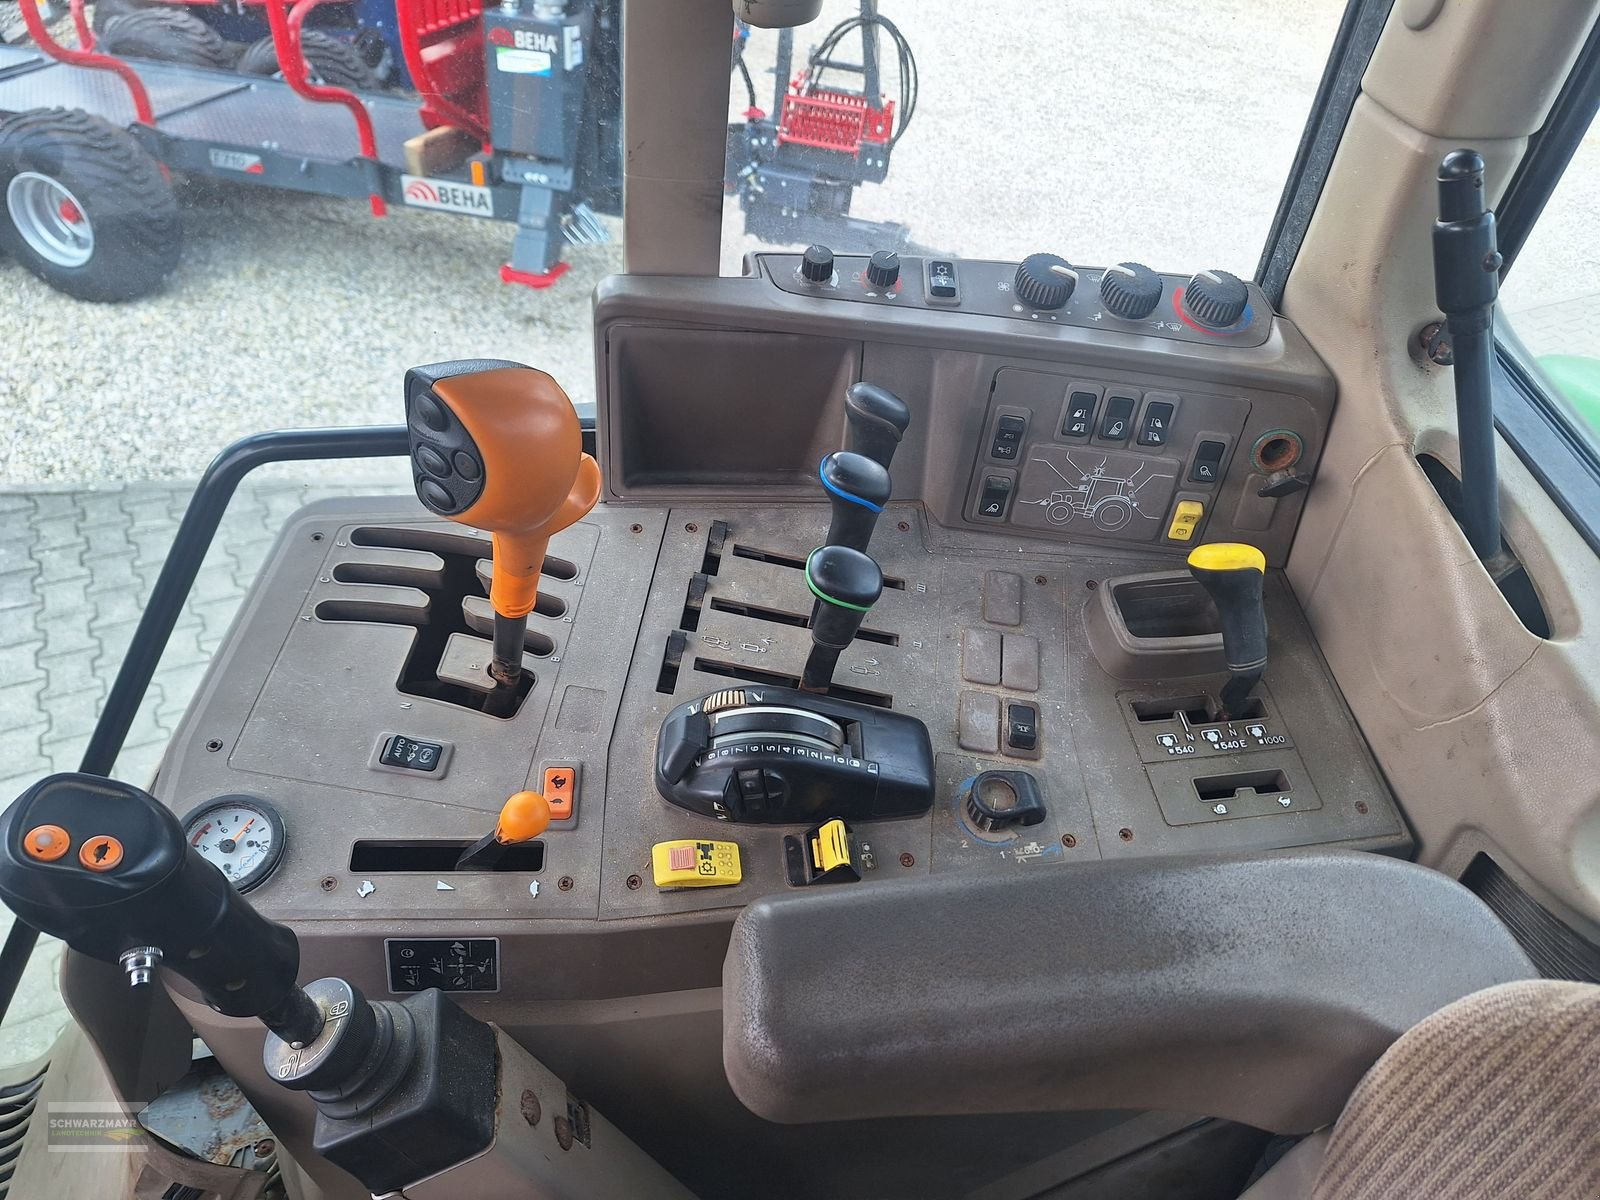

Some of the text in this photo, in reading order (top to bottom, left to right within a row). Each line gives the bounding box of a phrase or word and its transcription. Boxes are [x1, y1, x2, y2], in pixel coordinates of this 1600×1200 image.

[514, 30, 558, 54] BEHA
[437, 186, 489, 210] BEHA
[1186, 733, 1195, 741] N
[1228, 729, 1237, 737] N
[1264, 735, 1285, 745] 1000
[393, 738, 406, 758] AUTO
[1175, 745, 1195, 755] 540
[708, 752, 716, 760] 9
[782, 746, 791, 754] 4
[797, 748, 805, 756] 3
[810, 751, 819, 759] 2
[975, 762, 982, 771] 5
[220, 826, 229, 834] 6
[243, 826, 251, 834] 8
[961, 840, 968, 848] 2
[259, 844, 269, 854] 10
[232, 872, 241, 880] 0
